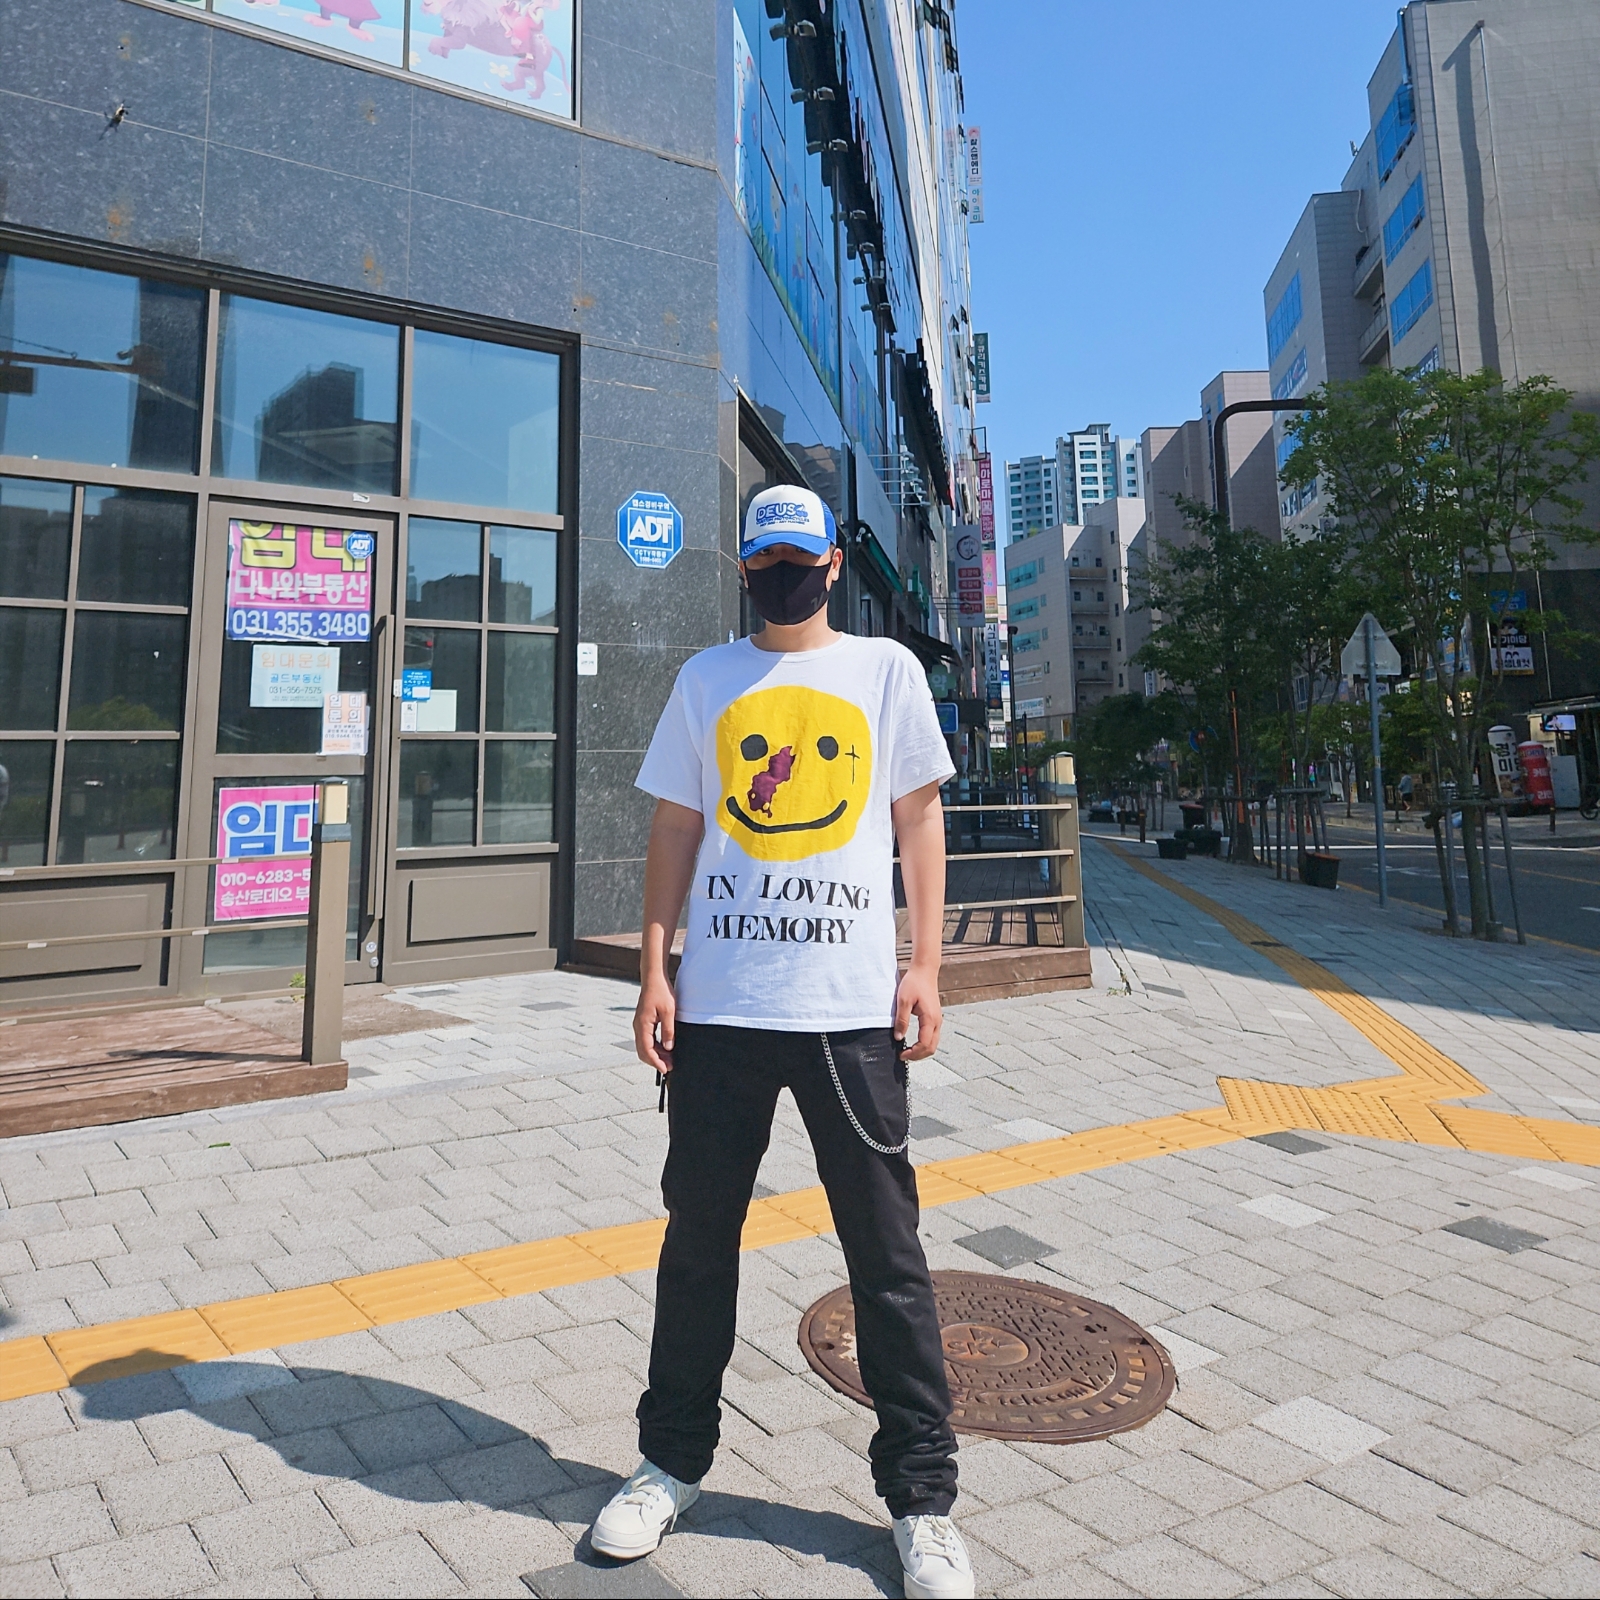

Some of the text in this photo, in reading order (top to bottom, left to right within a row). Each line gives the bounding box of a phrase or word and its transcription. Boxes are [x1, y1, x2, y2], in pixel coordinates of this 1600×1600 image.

[980, 469, 992, 499] 아로마
[756, 502, 796, 520] DEUS
[629, 515, 673, 544] ADT
[350, 539, 370, 551] ADT
[234, 569, 368, 604] 다나와부동산
[232, 609, 370, 637] 031.355.3480
[261, 652, 331, 669] 임대문의
[268, 686, 323, 694] 031-356-7575
[220, 889, 293, 907] 송산로데오
[706, 873, 871, 911] IN LOVING
[706, 914, 855, 944] MEMORY
